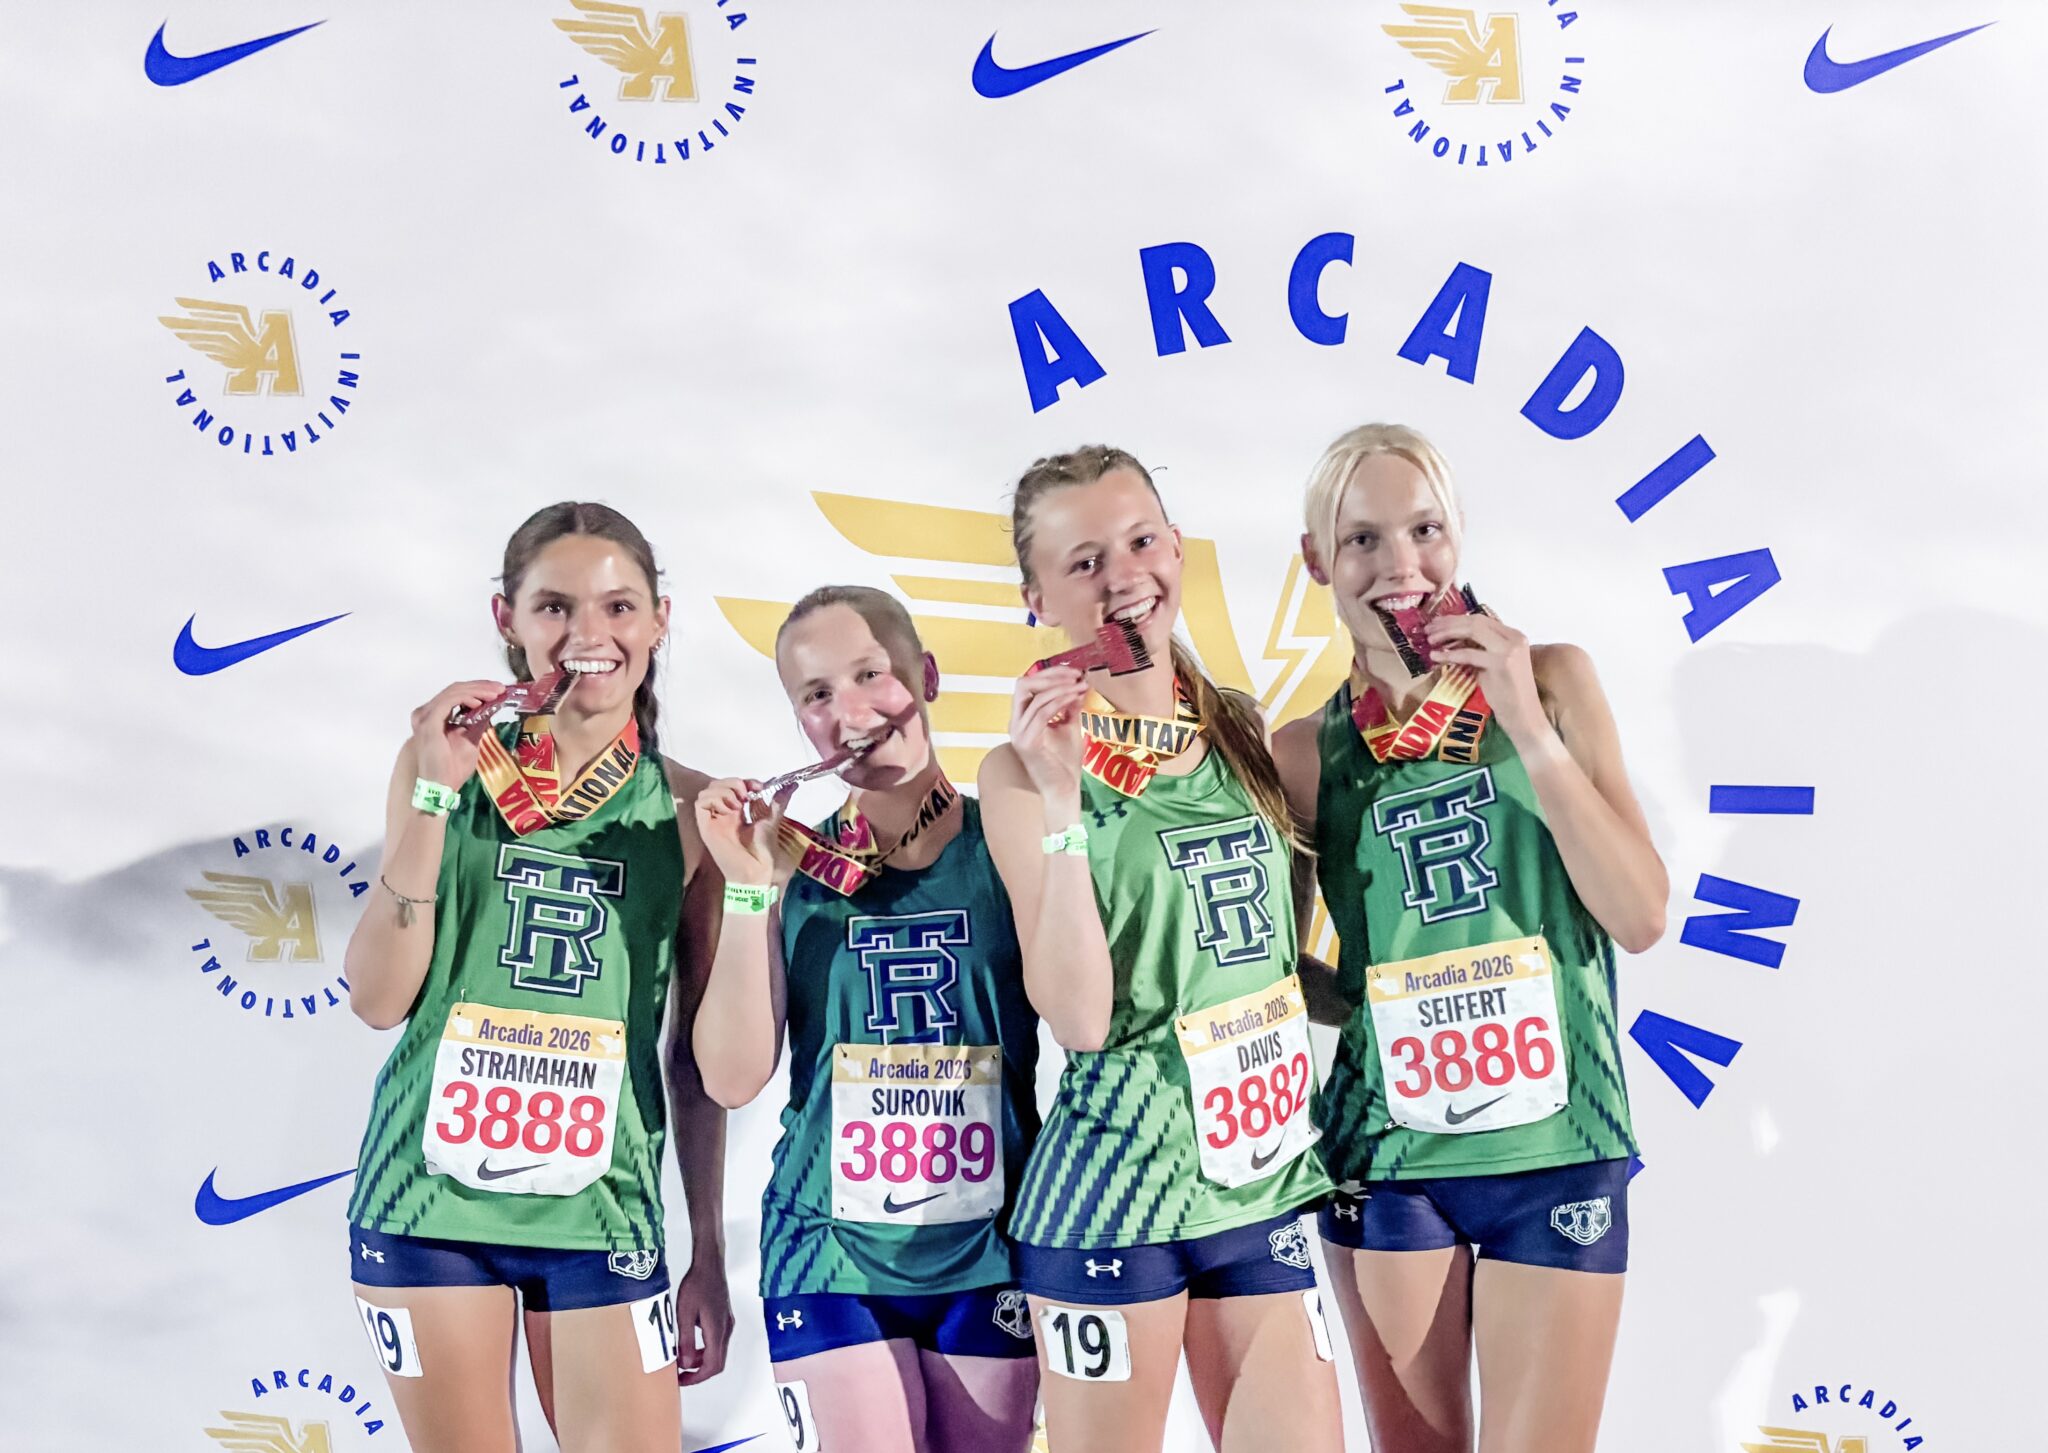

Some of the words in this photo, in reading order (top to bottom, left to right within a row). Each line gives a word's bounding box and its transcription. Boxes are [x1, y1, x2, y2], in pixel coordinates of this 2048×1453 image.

[560, 58, 757, 164] INVITATIONAL
[1385, 57, 1585, 166] INVITATIONAL
[207, 251, 350, 327] ARCADIA
[166, 353, 360, 456] INVITATIONAL
[1008, 231, 1782, 643] ARCADIA
[1626, 784, 1815, 1182] INV
[233, 827, 369, 898] ARCADIA
[191, 938, 350, 1018] ITATIONAL
[1405, 963, 1467, 992] Arcadia
[1471, 954, 1514, 981] 2026
[478, 1018, 543, 1047] Arcadia
[547, 1027, 591, 1052] 2026
[1209, 1009, 1264, 1042] Arcadia
[1264, 995, 1289, 1023] 2026
[1418, 987, 1507, 1028] SEIFERT
[460, 1047, 597, 1090] STRANAHAN
[869, 1058, 929, 1080] Arcadia
[934, 1058, 972, 1080] 2026
[1236, 1030, 1283, 1073] DAVIS
[1390, 1016, 1555, 1099] 3886
[436, 1080, 606, 1158] 3888
[871, 1088, 966, 1117] SUROVIK
[1203, 1052, 1309, 1150] 3882
[840, 1120, 996, 1184] 3889
[365, 1306, 403, 1373] 19
[1052, 1312, 1112, 1378] 19
[251, 1369, 384, 1436] ARCADIA
[778, 1386, 805, 1451] 9
[1792, 1384, 1924, 1452] ARCADIA
